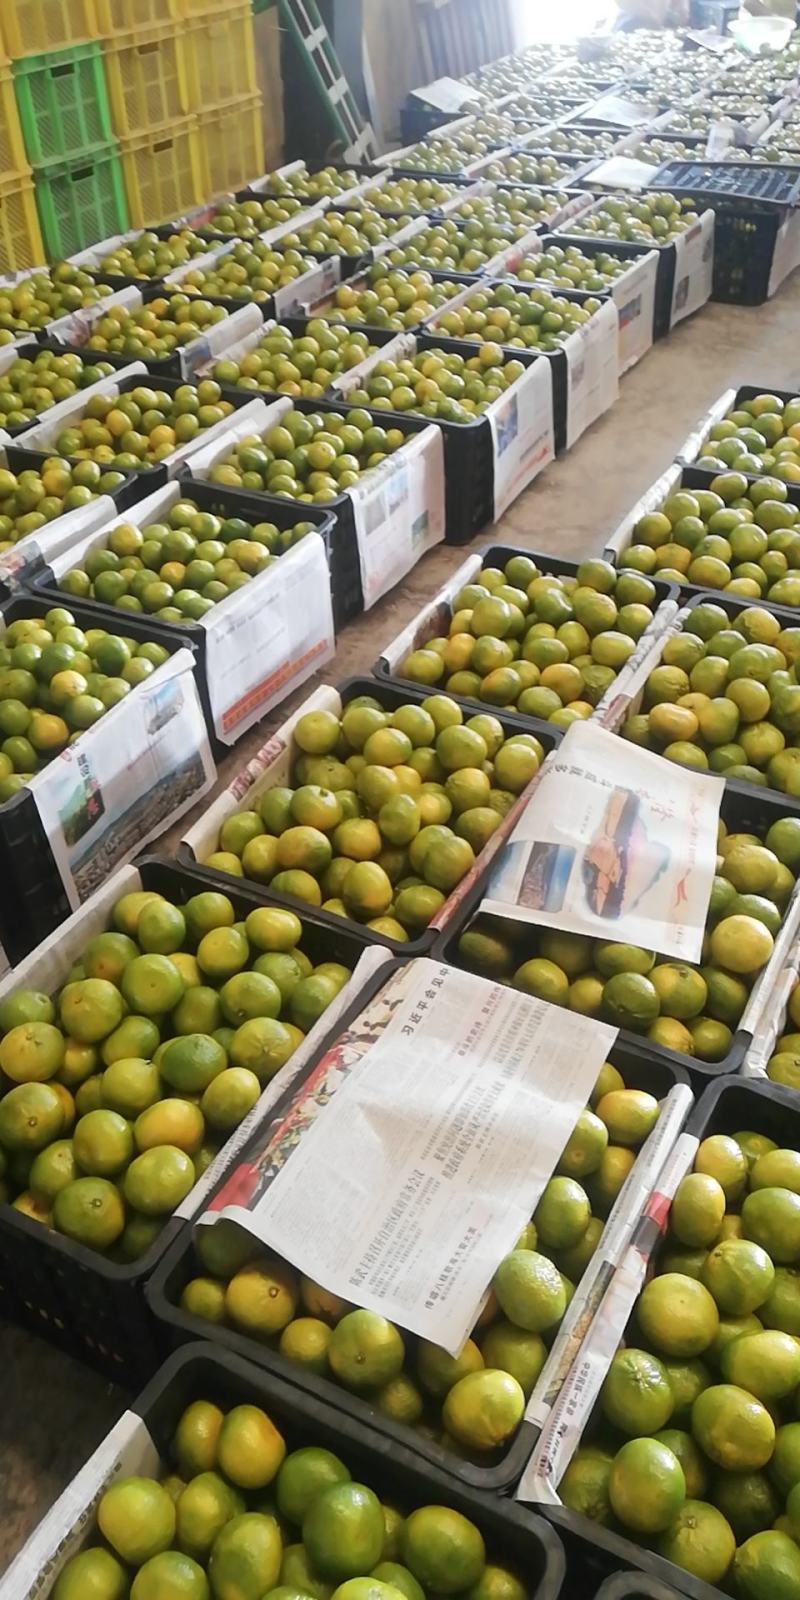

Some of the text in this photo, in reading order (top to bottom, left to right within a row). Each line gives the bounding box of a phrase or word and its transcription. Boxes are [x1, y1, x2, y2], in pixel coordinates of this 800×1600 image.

[401, 967, 451, 1036] 习近平会见中
